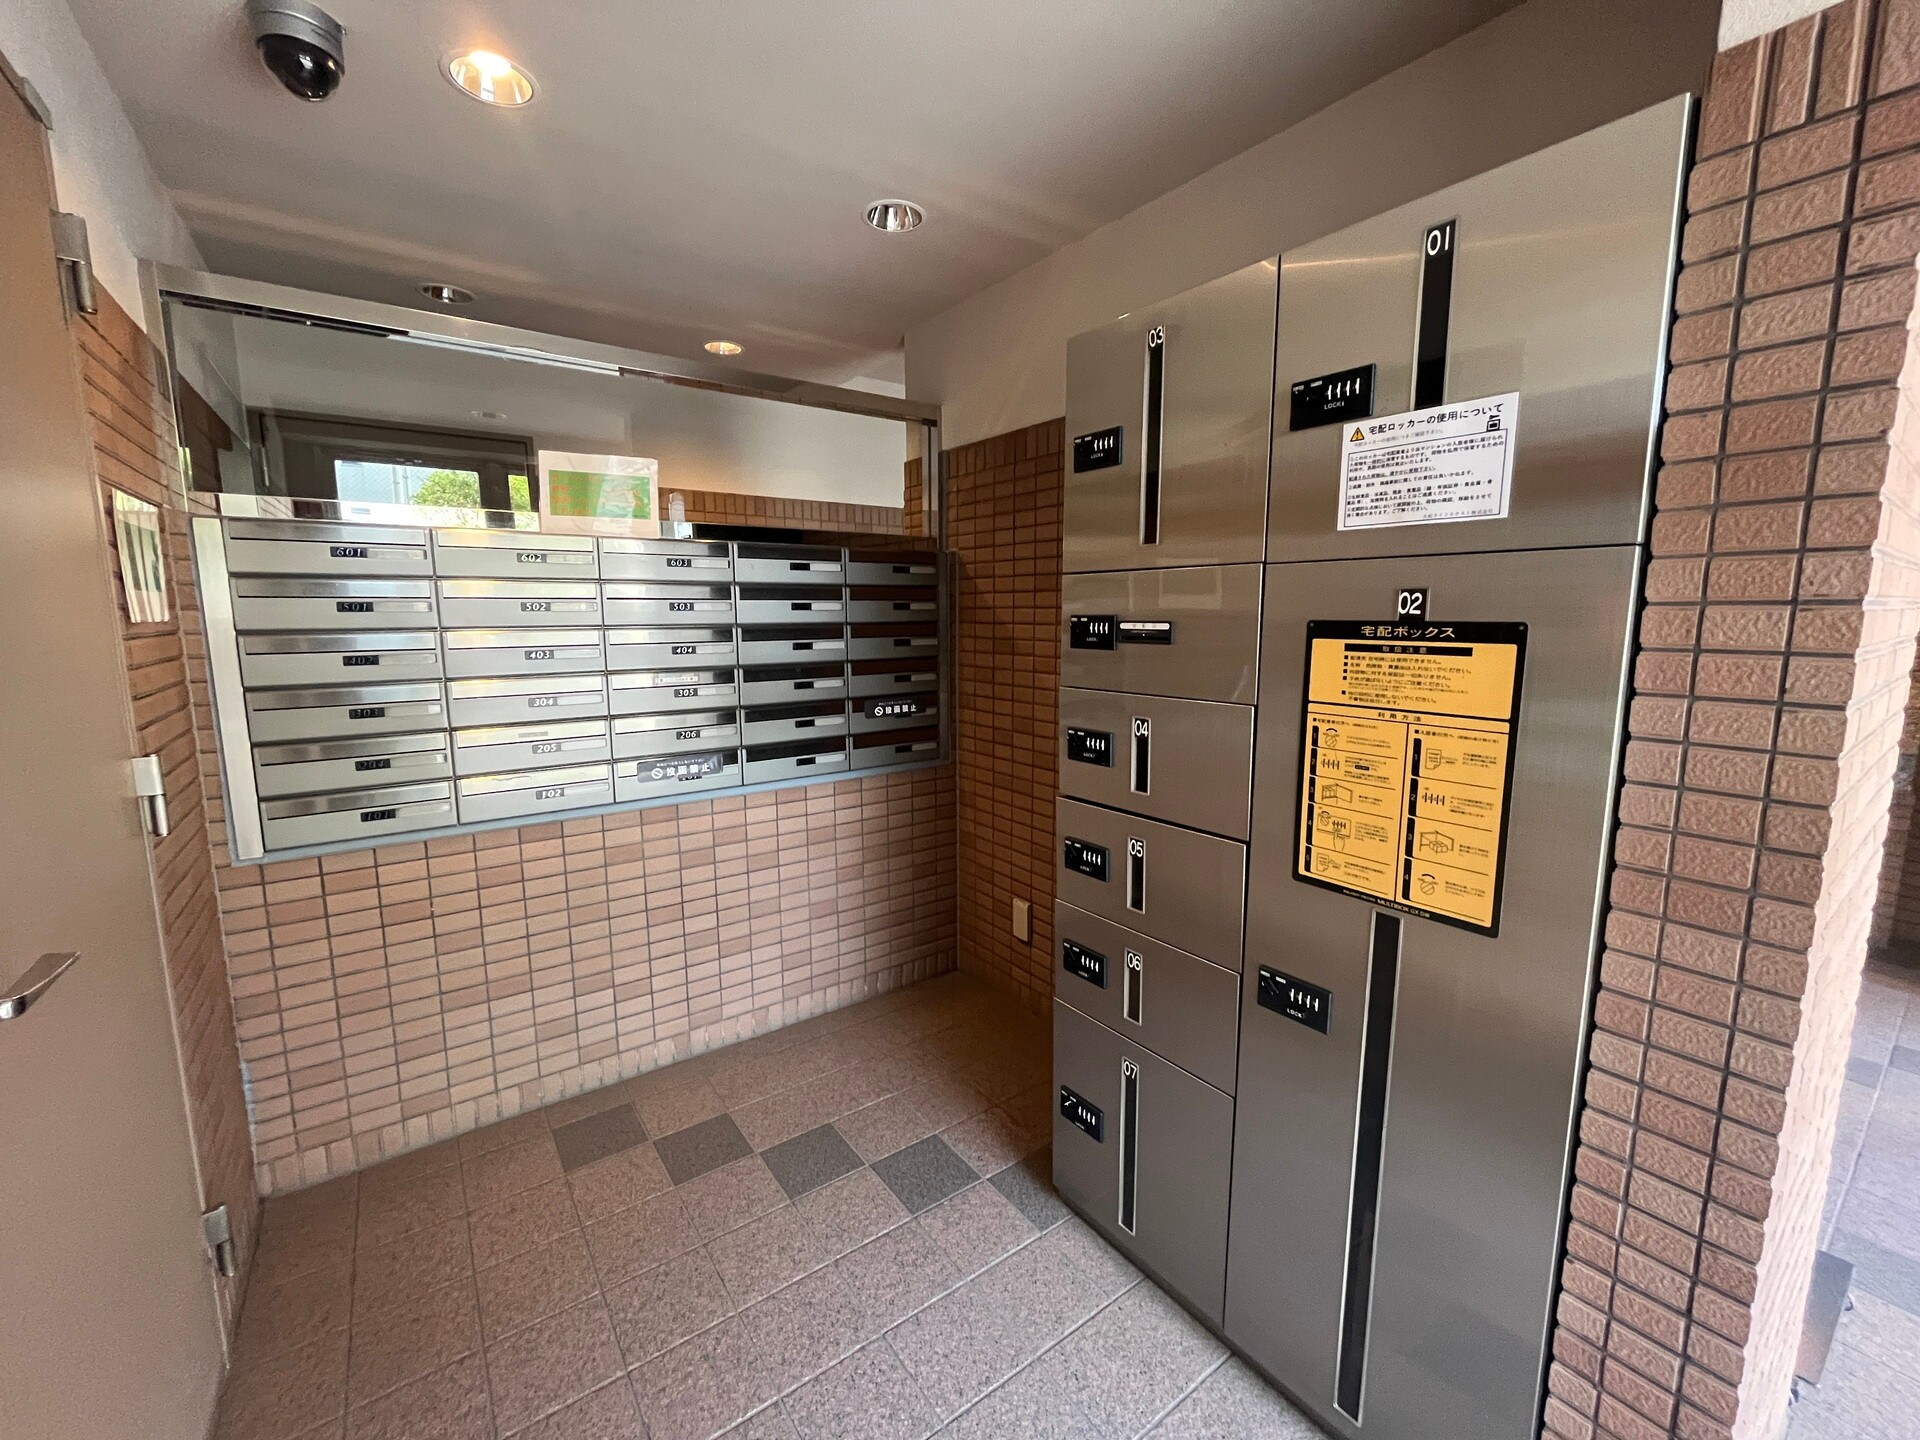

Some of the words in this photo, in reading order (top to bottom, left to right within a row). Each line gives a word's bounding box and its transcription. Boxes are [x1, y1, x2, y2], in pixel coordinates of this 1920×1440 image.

[1426, 225, 1451, 256] 01
[1149, 326, 1163, 347] 03
[1368, 401, 1504, 435] 宅配ロッカーの使用について
[336, 547, 361, 557] 601
[520, 553, 542, 563] 602
[670, 559, 688, 567] 603
[343, 602, 367, 612] 501
[525, 602, 546, 611] 502
[673, 602, 691, 611] 503
[1399, 591, 1423, 615] 02
[1359, 625, 1456, 639] 宅配ボックス
[529, 650, 550, 659] 403
[676, 646, 693, 654] 404
[678, 688, 694, 697] 305
[533, 697, 554, 707] 304
[1134, 720, 1149, 737] 04
[680, 730, 697, 739] 206
[536, 743, 557, 753] 205
[541, 789, 562, 799] 102
[1130, 839, 1143, 858] 05
[1127, 952, 1141, 971] 06
[1123, 1061, 1137, 1079] 07
